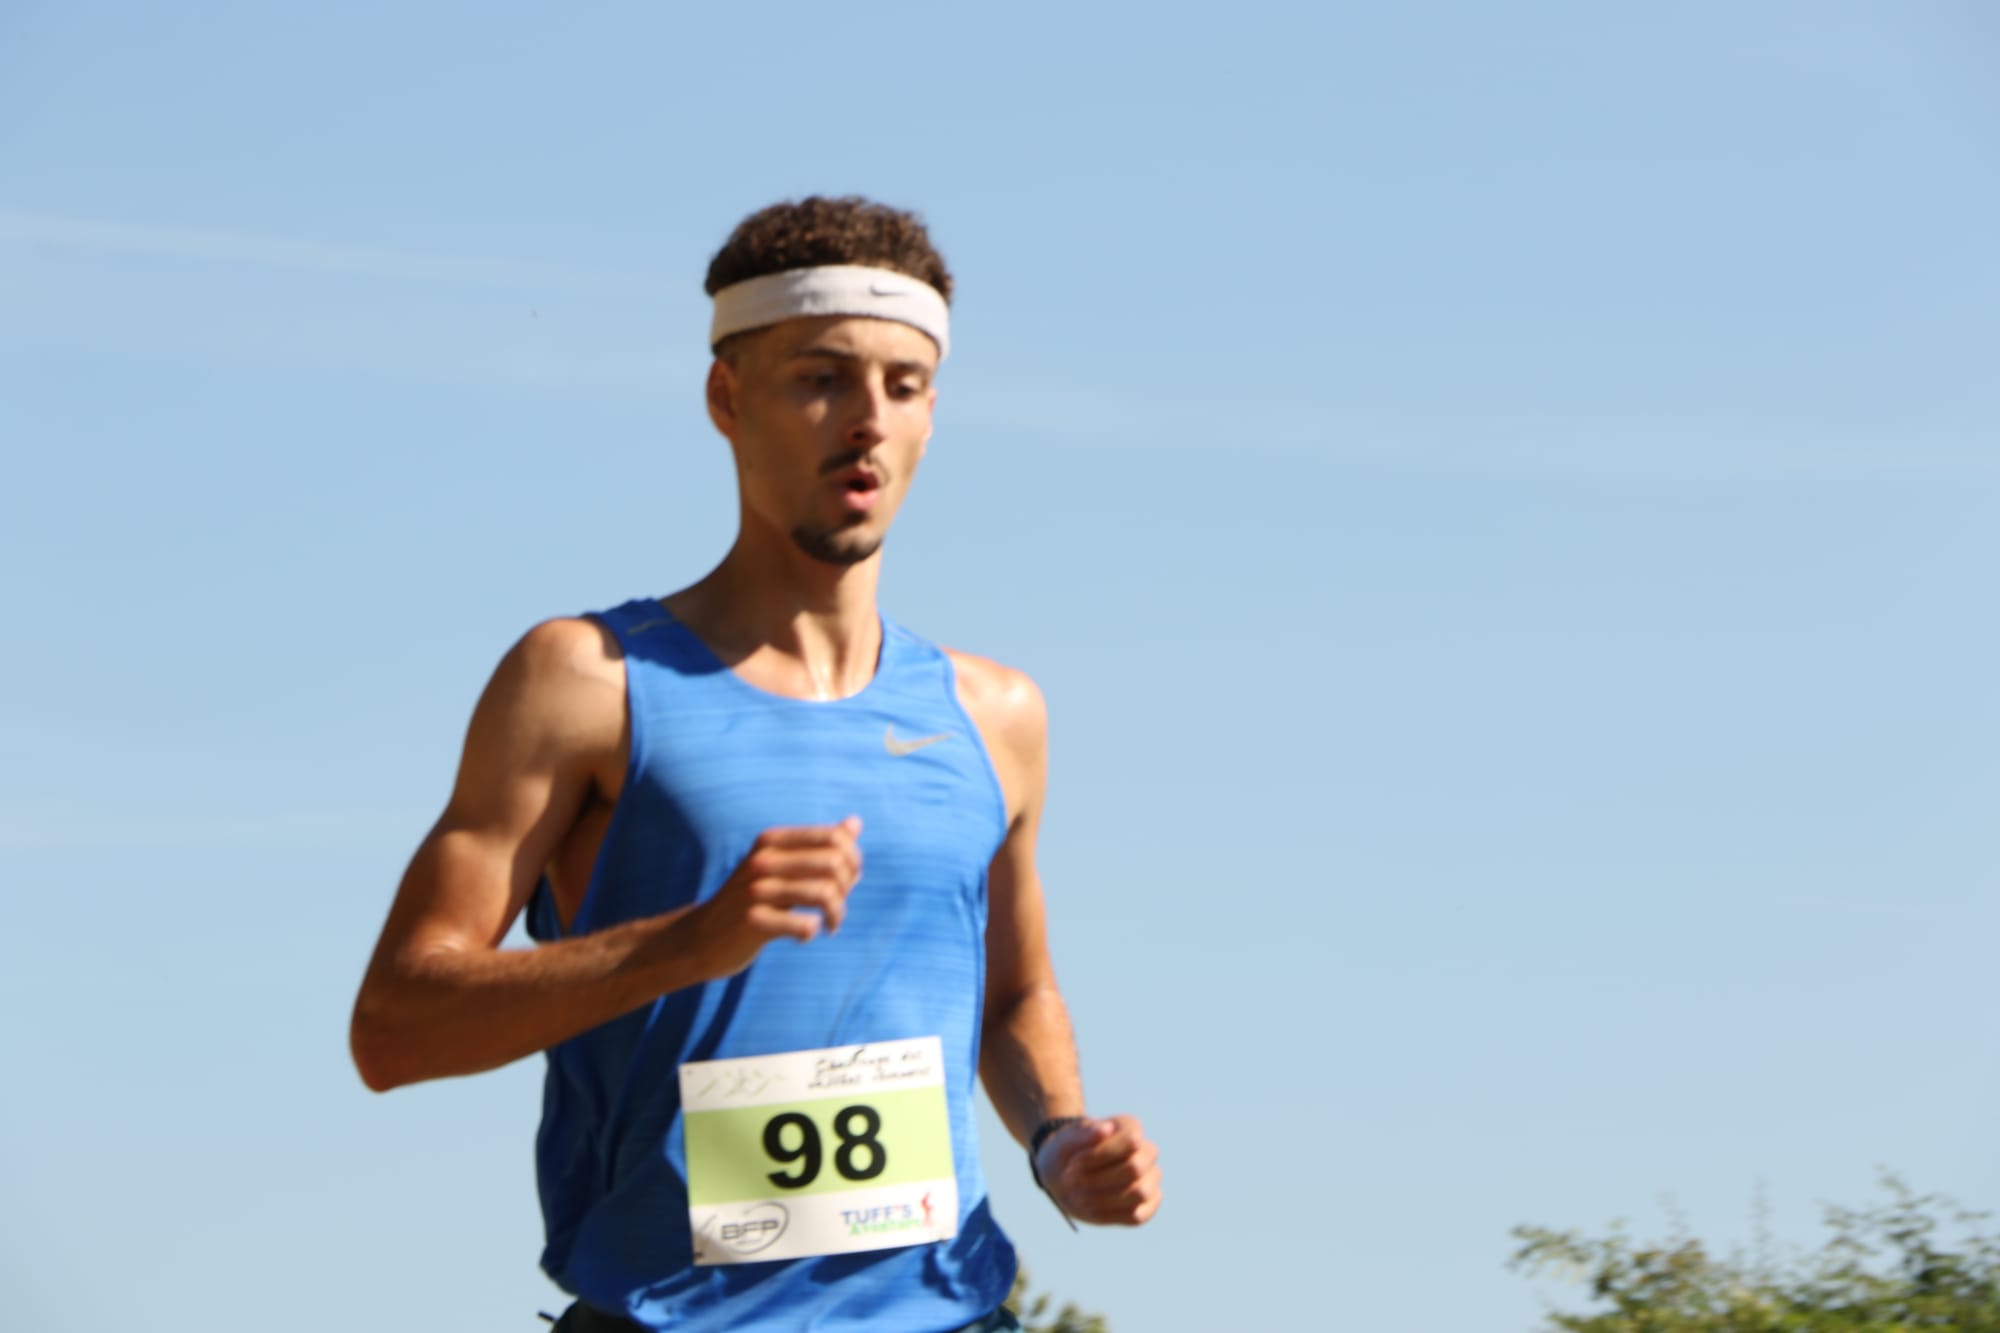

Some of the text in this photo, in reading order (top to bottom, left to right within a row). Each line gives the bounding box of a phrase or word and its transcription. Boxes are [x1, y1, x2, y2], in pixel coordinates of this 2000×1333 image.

[762, 1105, 887, 1190] 98
[839, 1203, 913, 1226] TUFF'S
[720, 1218, 780, 1241] BFP
